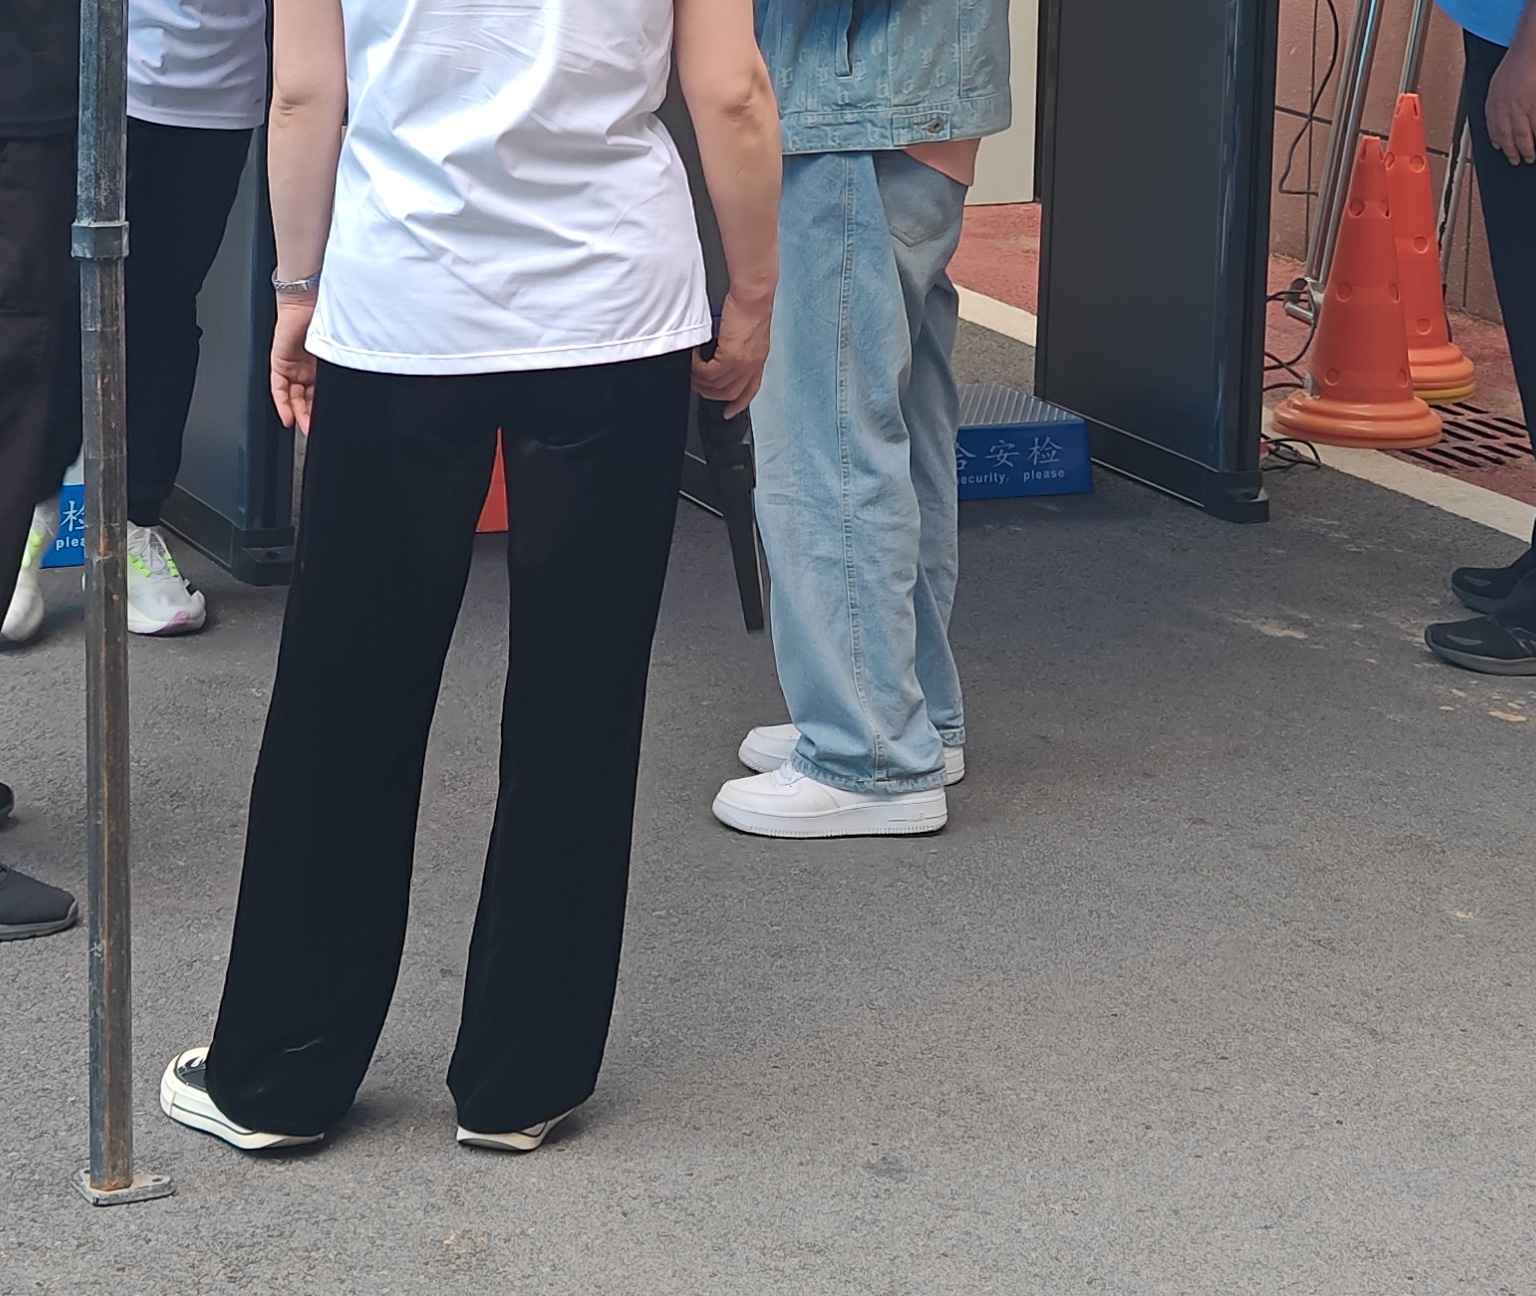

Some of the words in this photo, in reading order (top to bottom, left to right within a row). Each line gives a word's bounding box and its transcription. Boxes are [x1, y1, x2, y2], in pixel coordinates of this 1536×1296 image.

[957, 471, 1009, 485] ecurity,
[1023, 468, 1065, 483] please
[55, 535, 85, 552] plea
